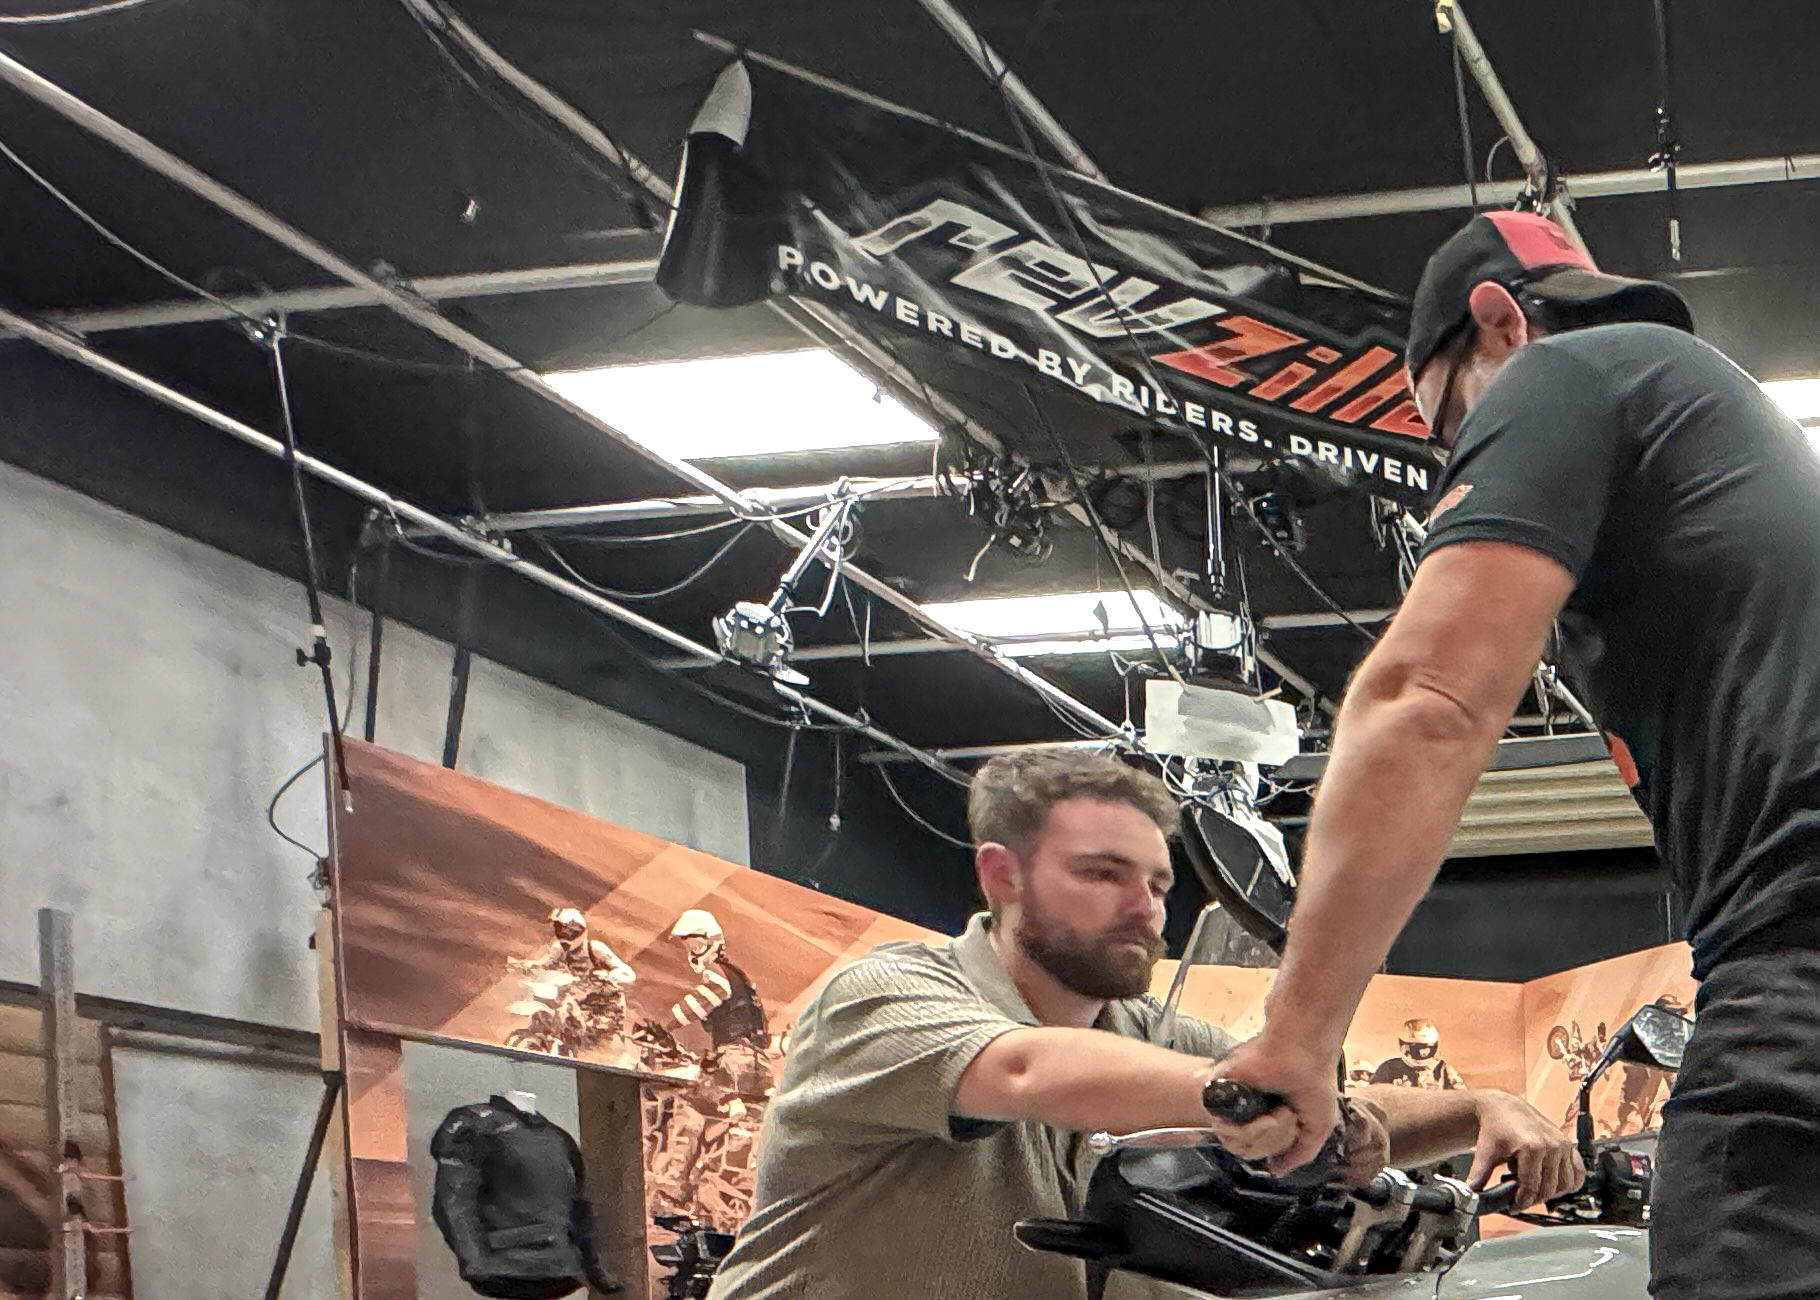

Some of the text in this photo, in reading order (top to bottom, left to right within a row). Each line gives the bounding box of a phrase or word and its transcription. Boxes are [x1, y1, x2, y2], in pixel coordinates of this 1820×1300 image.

[778, 245, 1429, 491] POWERED BY RIDERS. DRIVEN
